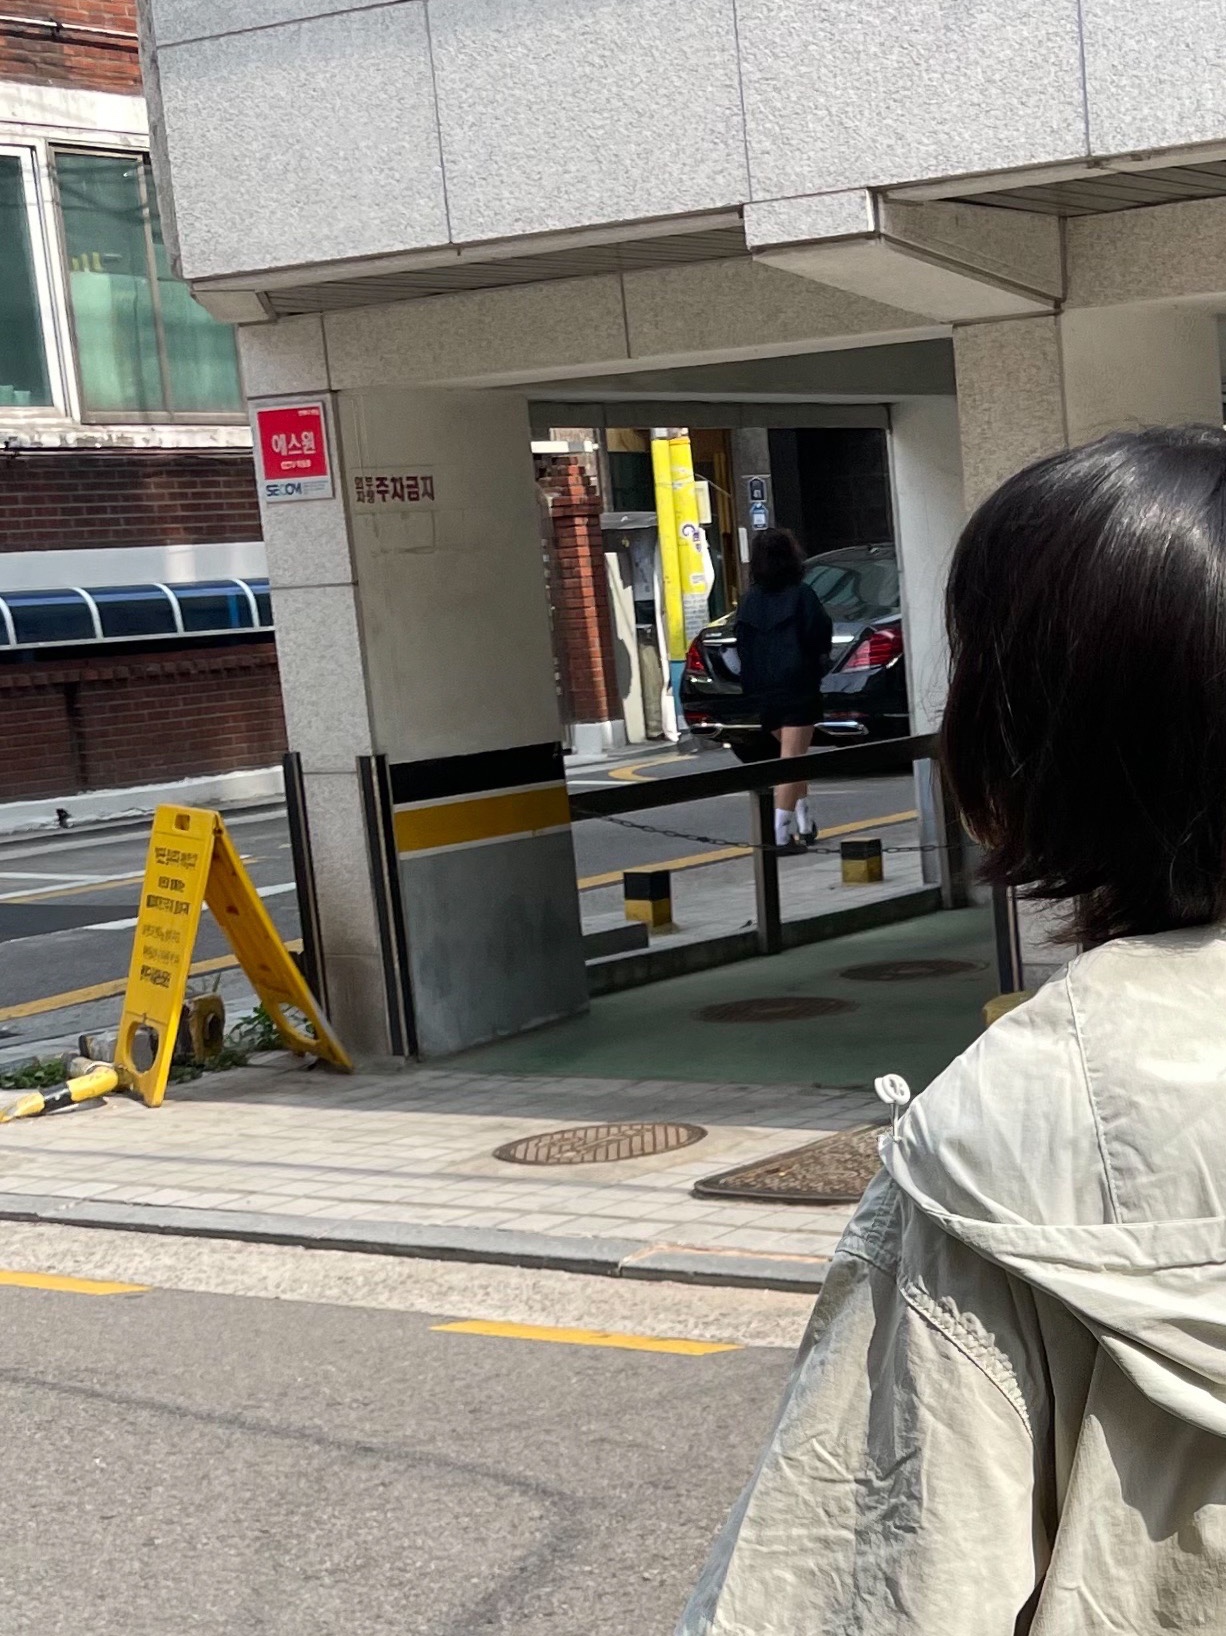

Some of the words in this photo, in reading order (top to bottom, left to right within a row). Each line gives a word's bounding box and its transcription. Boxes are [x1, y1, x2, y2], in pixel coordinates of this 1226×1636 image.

[271, 431, 316, 456] 에스원
[266, 482, 302, 497] SECOM
[375, 476, 435, 502] 주차금지
